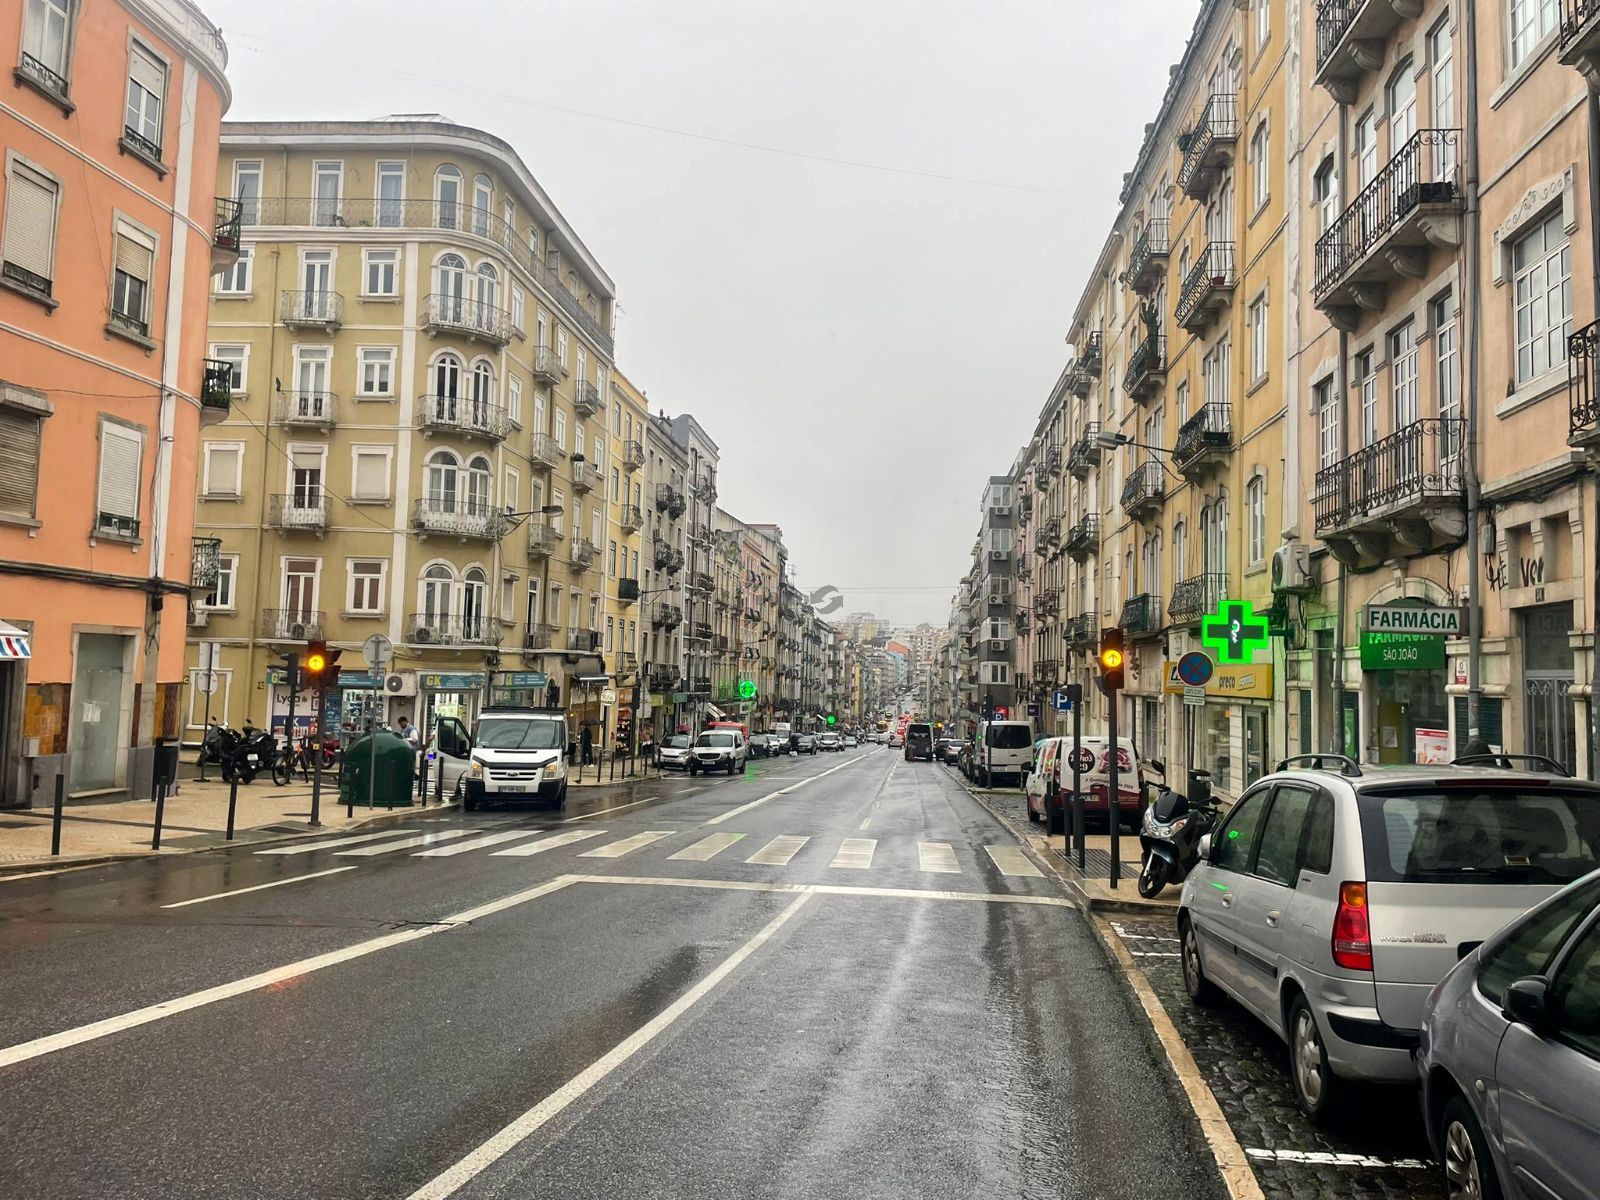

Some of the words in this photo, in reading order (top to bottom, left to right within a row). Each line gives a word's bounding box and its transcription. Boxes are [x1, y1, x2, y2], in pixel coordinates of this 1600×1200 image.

[1371, 609, 1458, 629] FARMÁCIA
[1383, 647, 1396, 660] SÃO
[1399, 646, 1417, 660] JOÃO
[427, 675, 442, 686] GK
[1056, 692, 1067, 709] P
